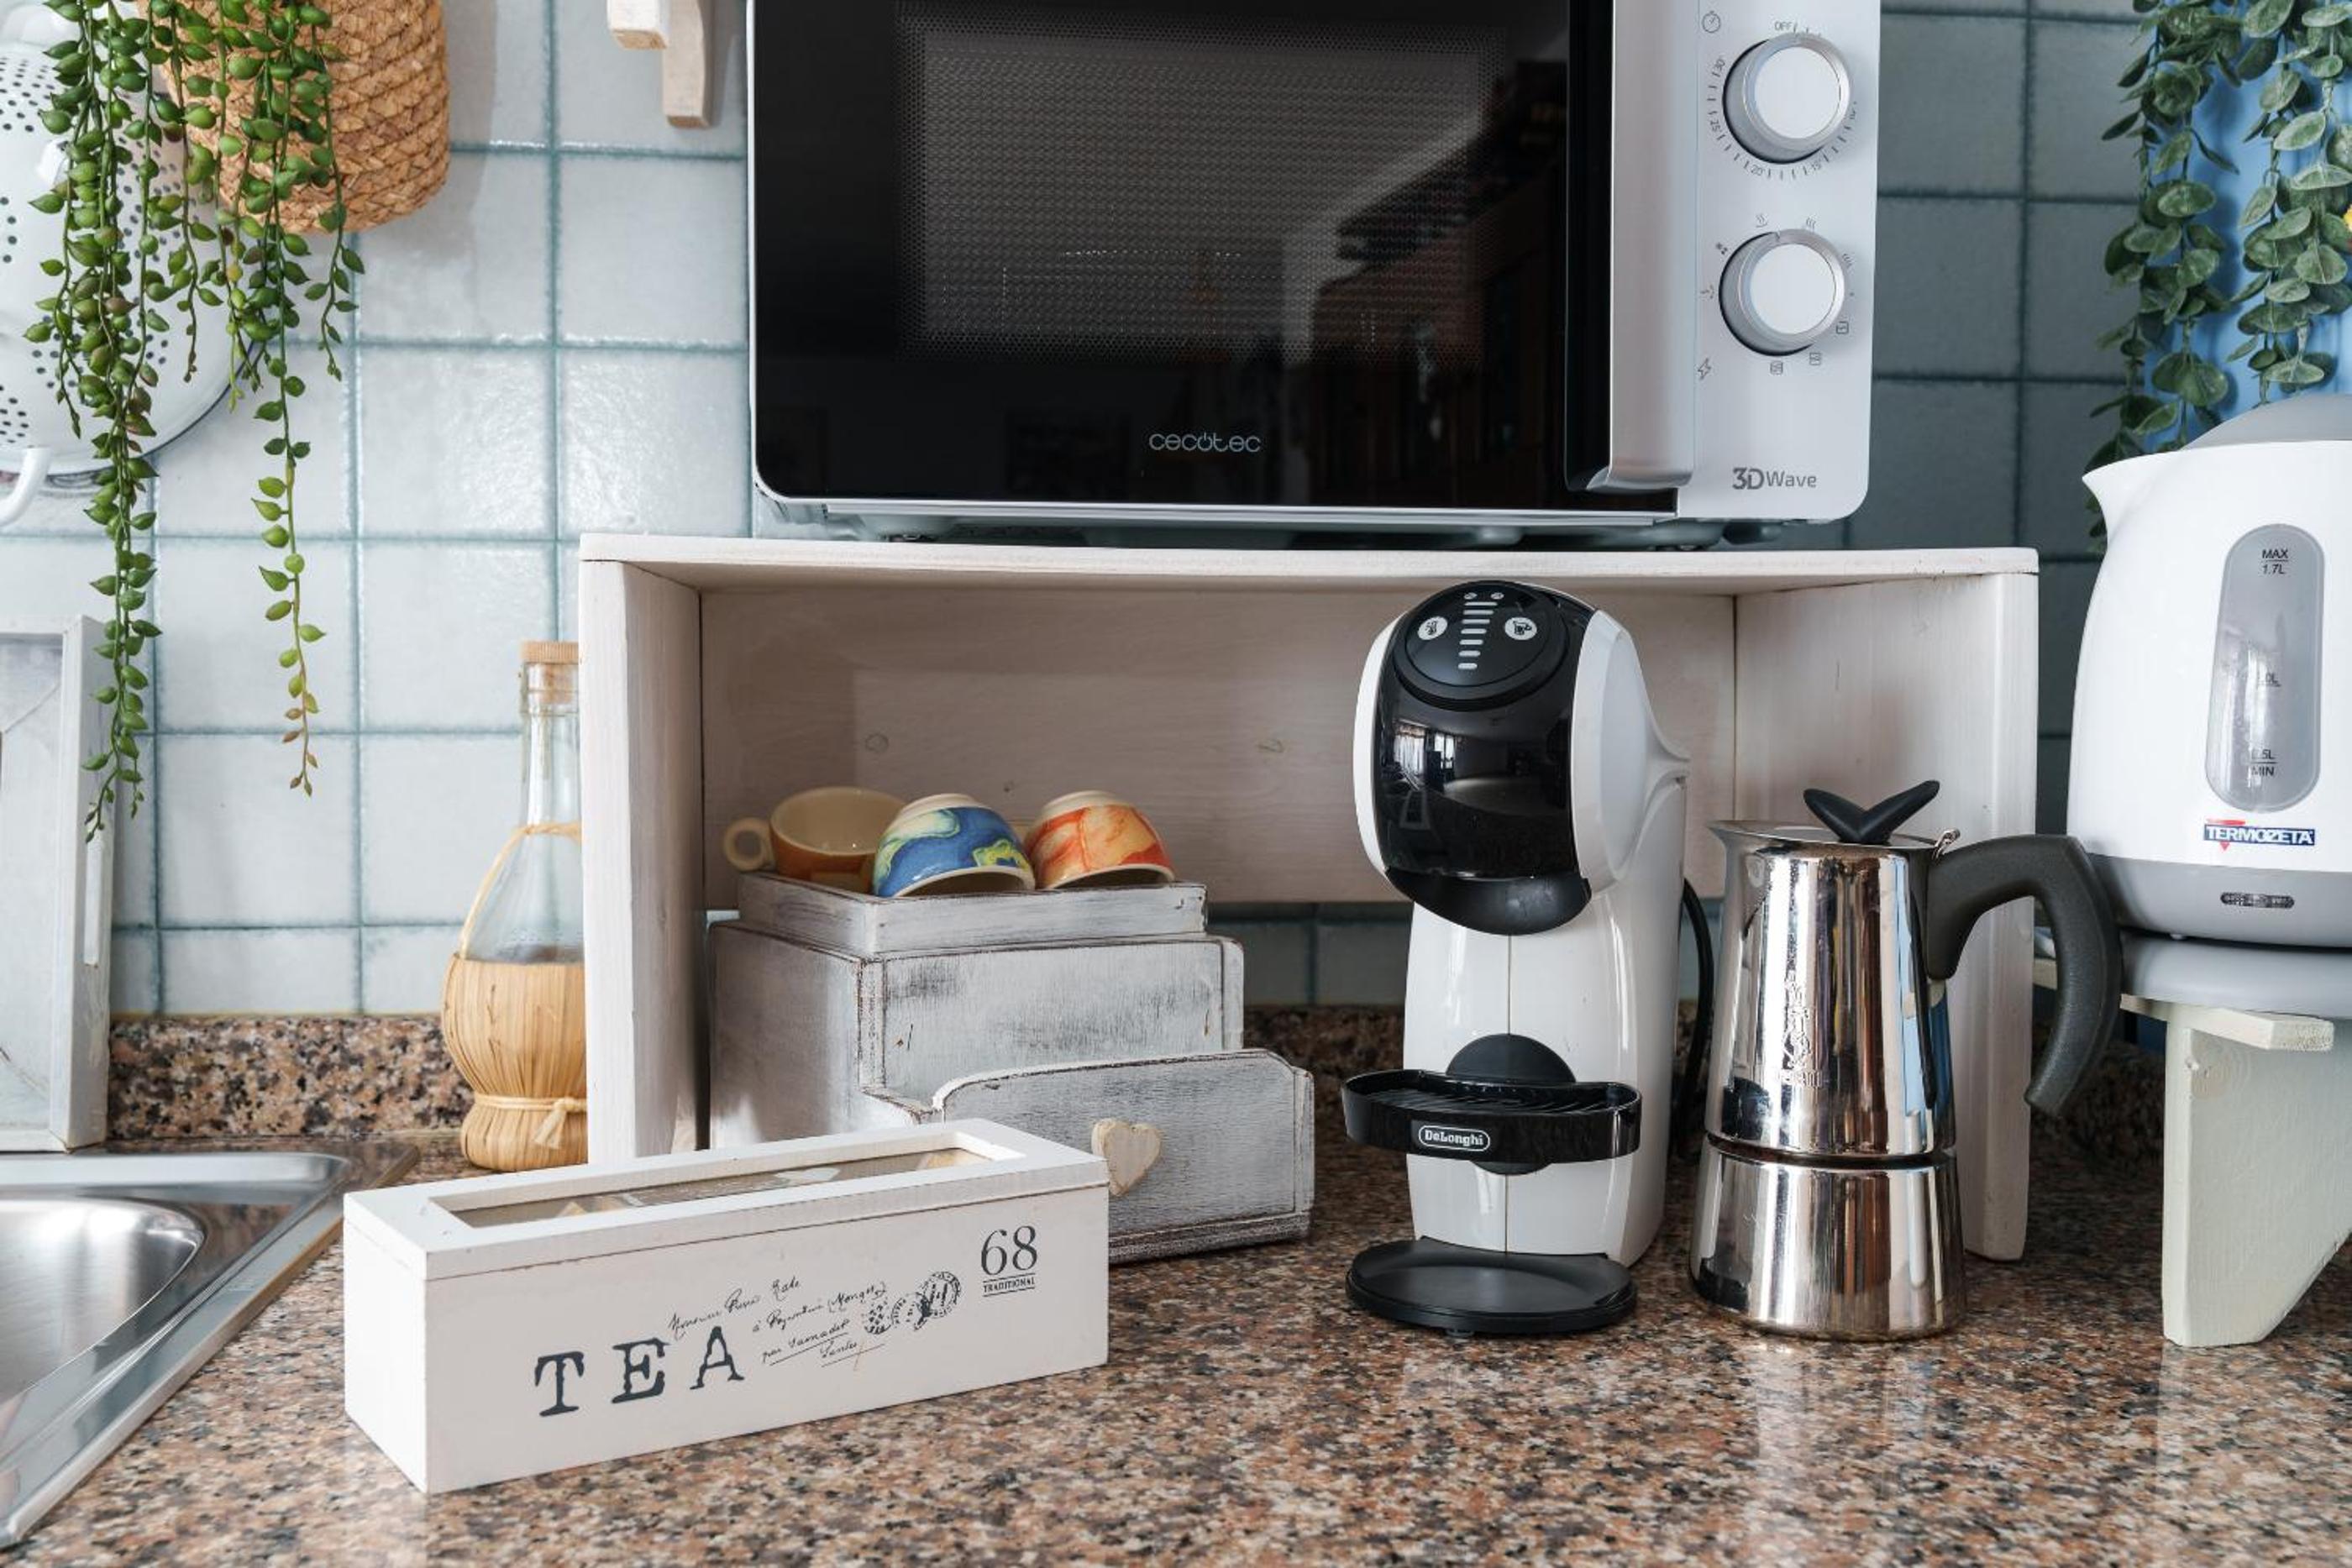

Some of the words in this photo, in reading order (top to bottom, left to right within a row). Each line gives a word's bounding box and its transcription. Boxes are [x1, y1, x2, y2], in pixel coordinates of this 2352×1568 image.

[1148, 432, 1261, 453] cecotec
[2261, 548, 2289, 559] MAX
[2261, 564, 2286, 574] 1.7L
[2251, 766, 2275, 777] MIN
[2207, 826, 2313, 845] TERMOZETA
[980, 1225, 1037, 1276] 68
[983, 1277, 1036, 1293] TRADITIONAL
[534, 1326, 745, 1418] TEA
